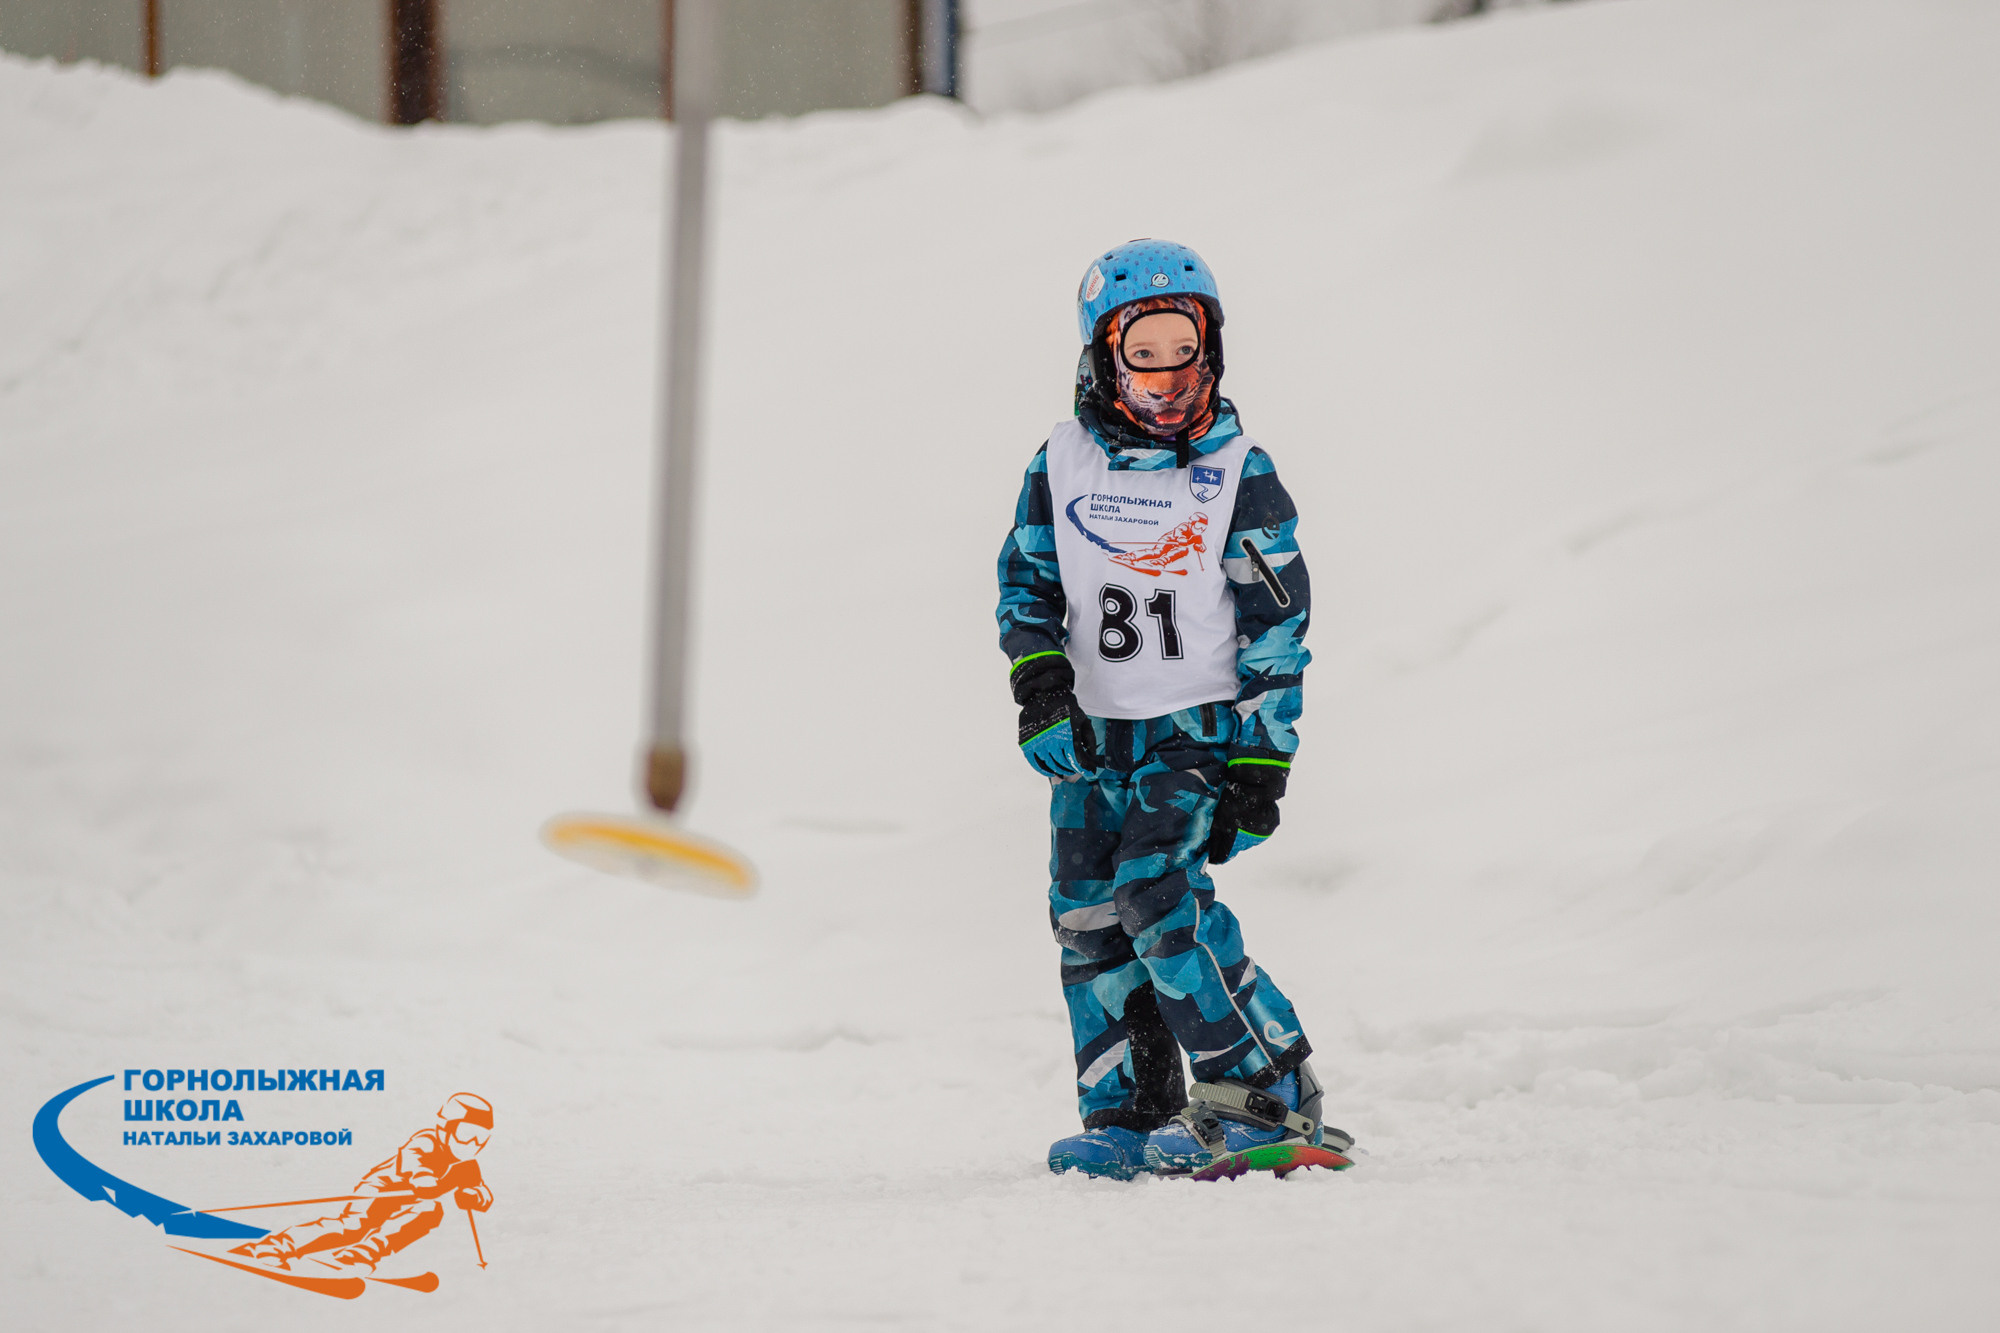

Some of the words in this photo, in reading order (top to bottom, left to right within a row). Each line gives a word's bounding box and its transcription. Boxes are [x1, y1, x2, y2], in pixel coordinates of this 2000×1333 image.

[1091, 493, 1172, 509] ГОРНОЛЫЖНАЯ
[1090, 503, 1121, 513] ШКОЛА
[1114, 516, 1159, 526] ЗАХАРОВОЙ
[1098, 583, 1184, 663] 81
